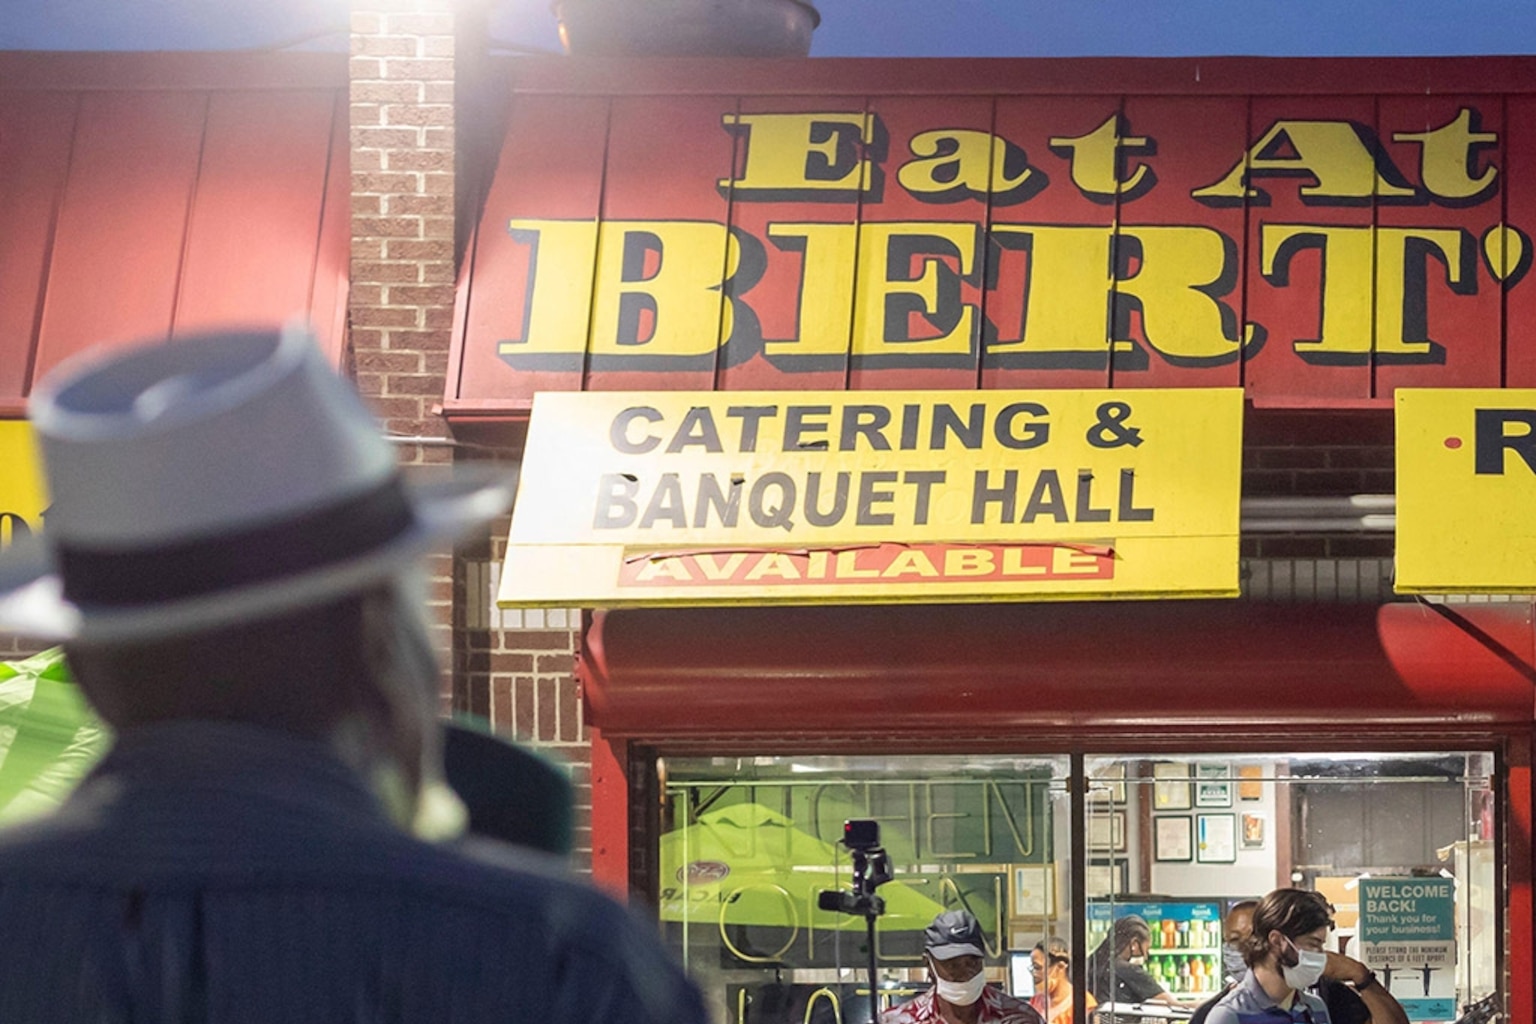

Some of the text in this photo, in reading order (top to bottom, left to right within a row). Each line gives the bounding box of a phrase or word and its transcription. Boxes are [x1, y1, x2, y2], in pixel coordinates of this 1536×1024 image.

[719, 108, 1499, 207] Eat At
[609, 401, 1144, 454] CATERING &
[593, 468, 1154, 532] BANQUET HALL
[636, 546, 1100, 581] AVAILABLE
[1366, 885, 1449, 898] WELCOME
[1366, 900, 1416, 913] BACK!
[1366, 913, 1437, 926] Thank you for
[1366, 924, 1441, 936] your business!
